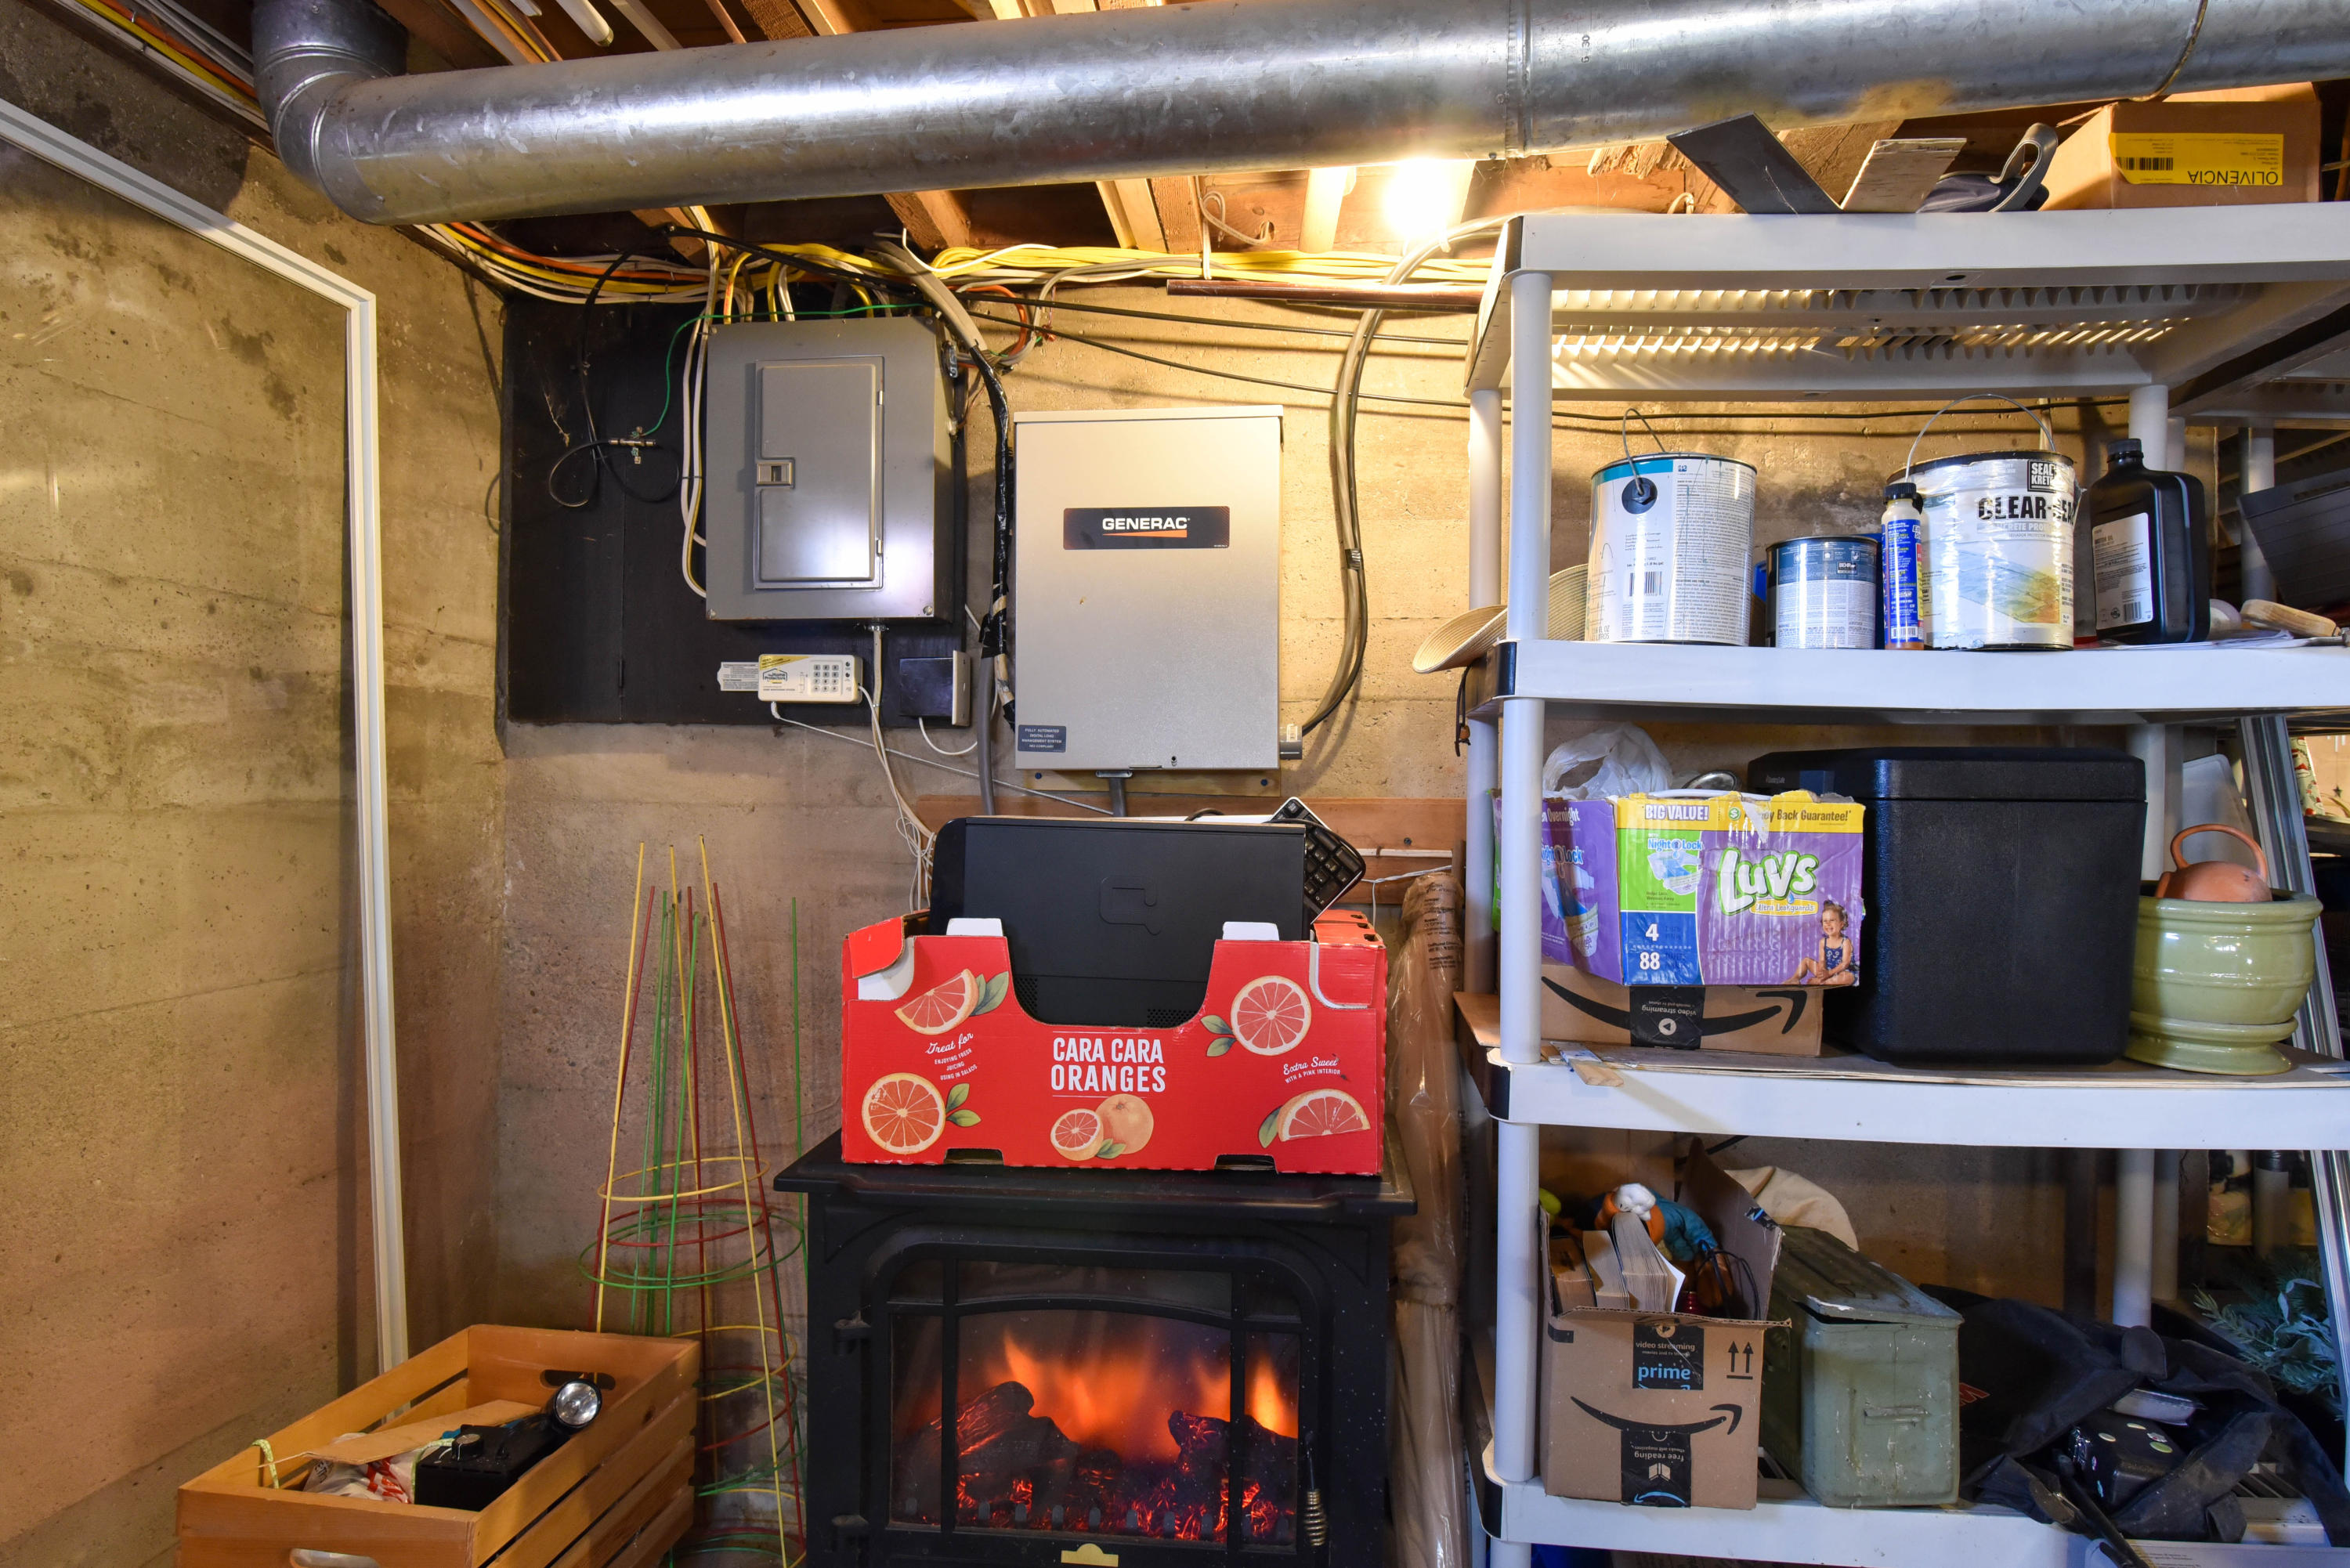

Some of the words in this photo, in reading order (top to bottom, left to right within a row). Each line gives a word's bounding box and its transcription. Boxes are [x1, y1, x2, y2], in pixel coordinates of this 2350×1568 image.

[1582, 34, 1590, 48] 30
[2187, 170, 2279, 185] OLIVENCIA
[2031, 475, 2051, 486] KRET
[1102, 517, 1188, 530] GENERAC
[1547, 807, 1580, 826] Overnight
[1645, 804, 1666, 820] BIG
[1667, 804, 1709, 821] VALUE!
[1777, 809, 1799, 821] Back
[1647, 838, 1672, 851] Night
[1682, 838, 1703, 851] Lock
[1542, 845, 1555, 865] ight
[1562, 845, 1583, 865] Lock
[1755, 902, 1774, 912] Ultra
[1776, 903, 1814, 912] Leakguards
[1645, 923, 1659, 941] 4
[1640, 952, 1661, 970] 88
[1641, 1004, 1676, 1013] streaming
[925, 1040, 956, 1054] Great
[958, 1033, 974, 1050] for
[1053, 1037, 1105, 1063] CARA
[1111, 1039, 1164, 1064] CARA
[934, 1055, 957, 1064] ENJOYING
[958, 1048, 972, 1058] FRESH
[946, 1061, 965, 1071] JUICING
[960, 1064, 978, 1075] SALADS
[1283, 1063, 1309, 1075] Extra
[1311, 1056, 1338, 1068] Sweet
[1051, 1064, 1166, 1093] ORANGES
[1285, 1075, 1297, 1084] WITH
[1658, 1342, 1695, 1352] streaming
[1638, 1363, 1691, 1382] prime
[1634, 1451, 1665, 1460] reading
